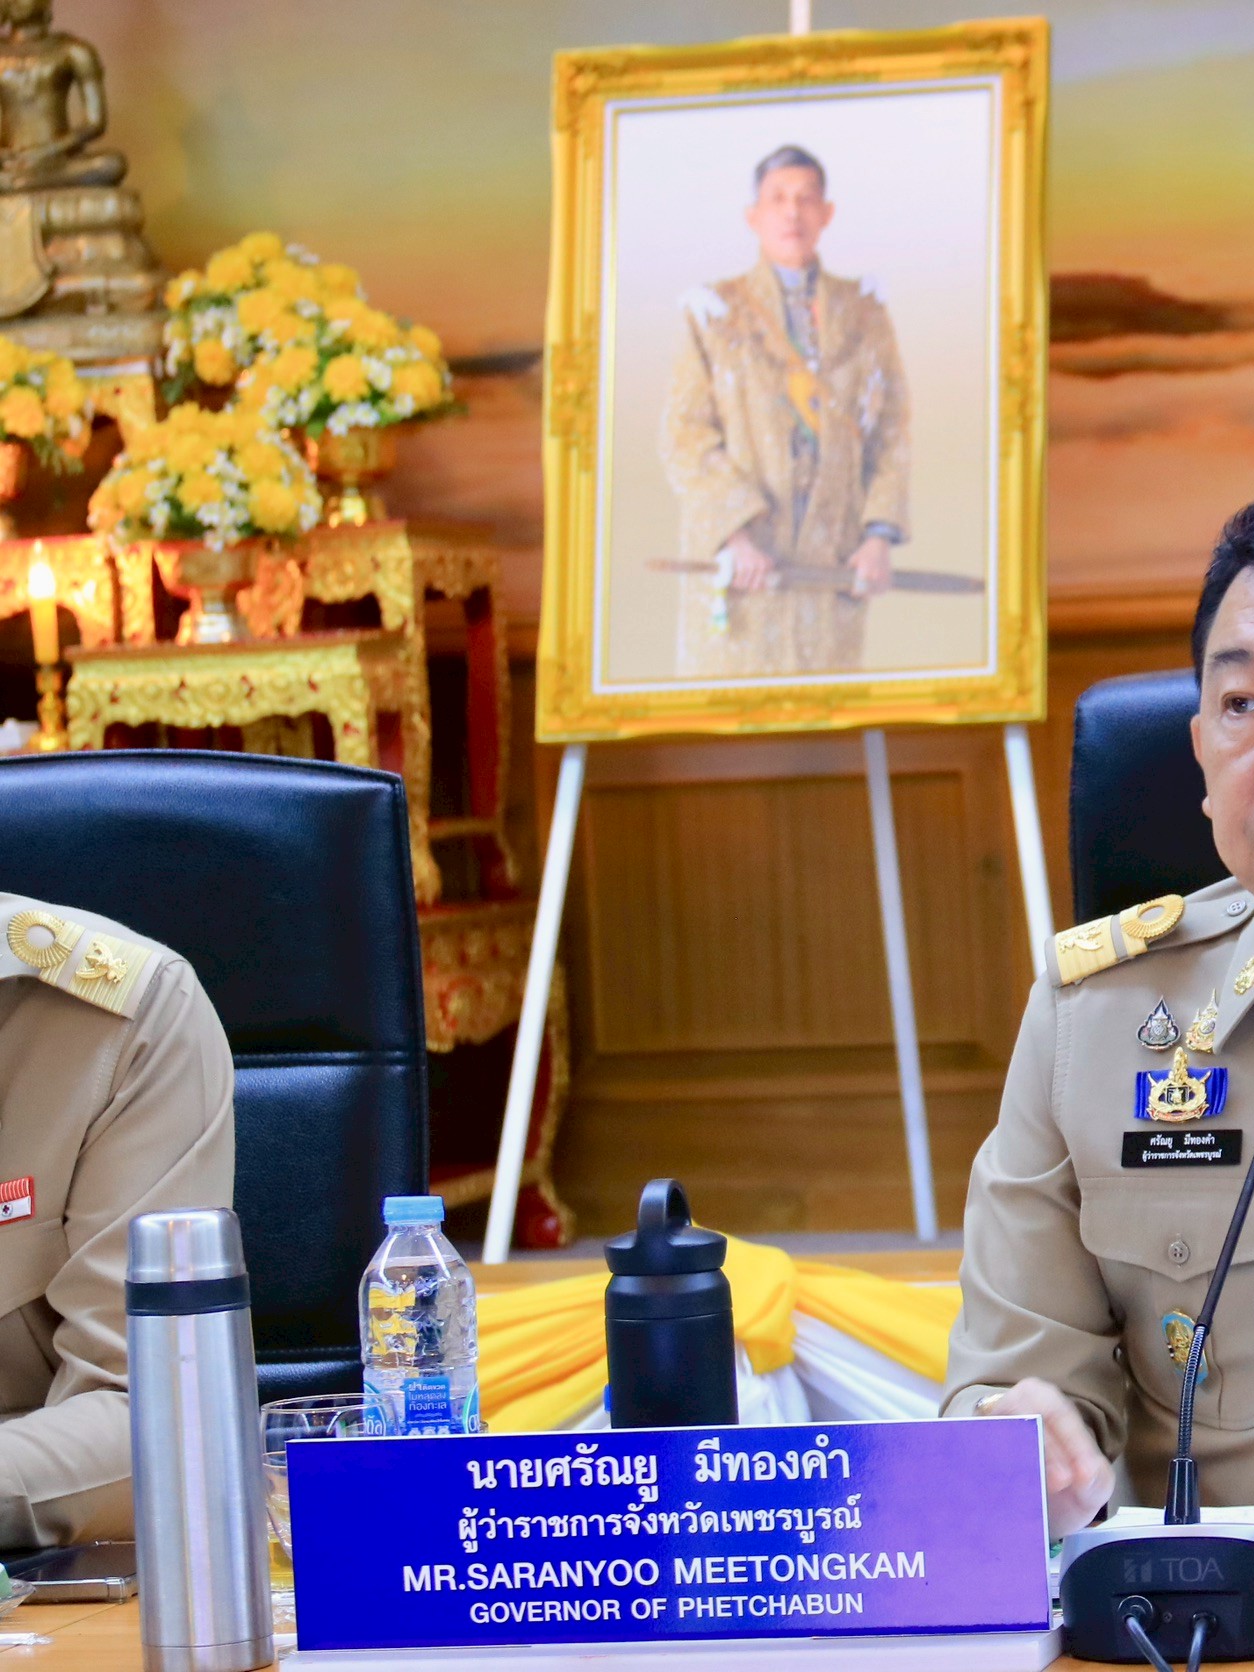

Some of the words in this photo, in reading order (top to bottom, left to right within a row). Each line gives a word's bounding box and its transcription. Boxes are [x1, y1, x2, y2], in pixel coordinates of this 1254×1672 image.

[1149, 1134, 1173, 1149] ศรัณยู
[1184, 1133, 1215, 1146] มีทองคำ
[466, 1443, 659, 1503] นายศรัณยู
[694, 1433, 851, 1483] มีทองคำ
[458, 1493, 862, 1553] ผู้ว่าราชการจังหวัดเพชรบูรณ์
[402, 1558, 660, 1592] MR.SARANYOO
[674, 1551, 926, 1584] MEETONGKAM
[1160, 1557, 1225, 1582] TOA
[470, 1599, 621, 1624] GOVERNOR
[631, 1598, 668, 1620] OF
[678, 1593, 864, 1618] PHETCHABUN
